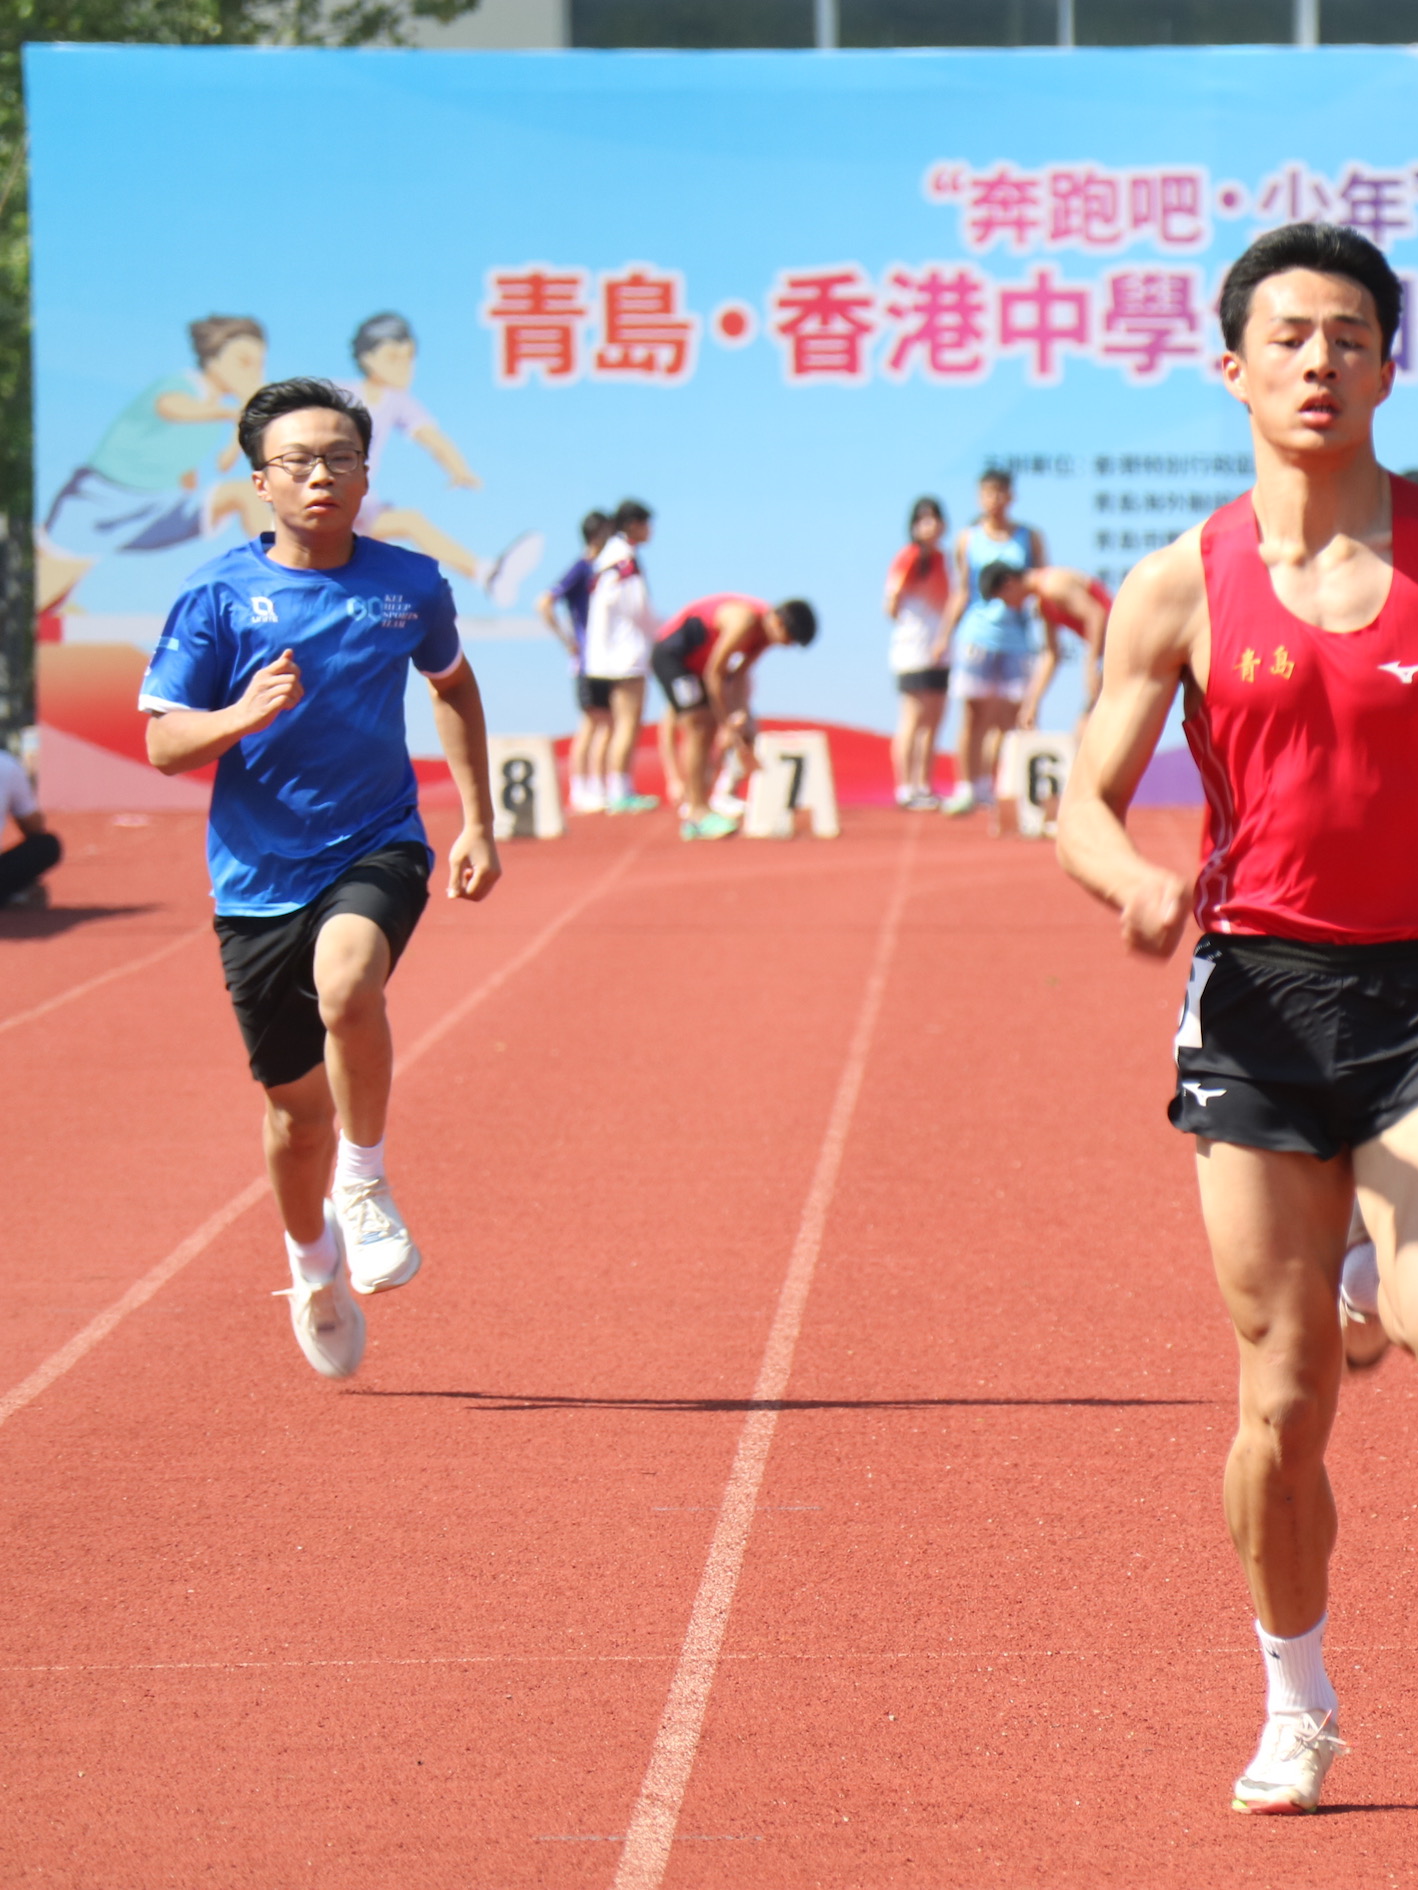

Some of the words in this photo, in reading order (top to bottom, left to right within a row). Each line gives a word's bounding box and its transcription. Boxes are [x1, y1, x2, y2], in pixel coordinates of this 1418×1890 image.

[502, 757, 536, 813] 8
[780, 754, 805, 810] 7
[1028, 752, 1060, 808] 6
